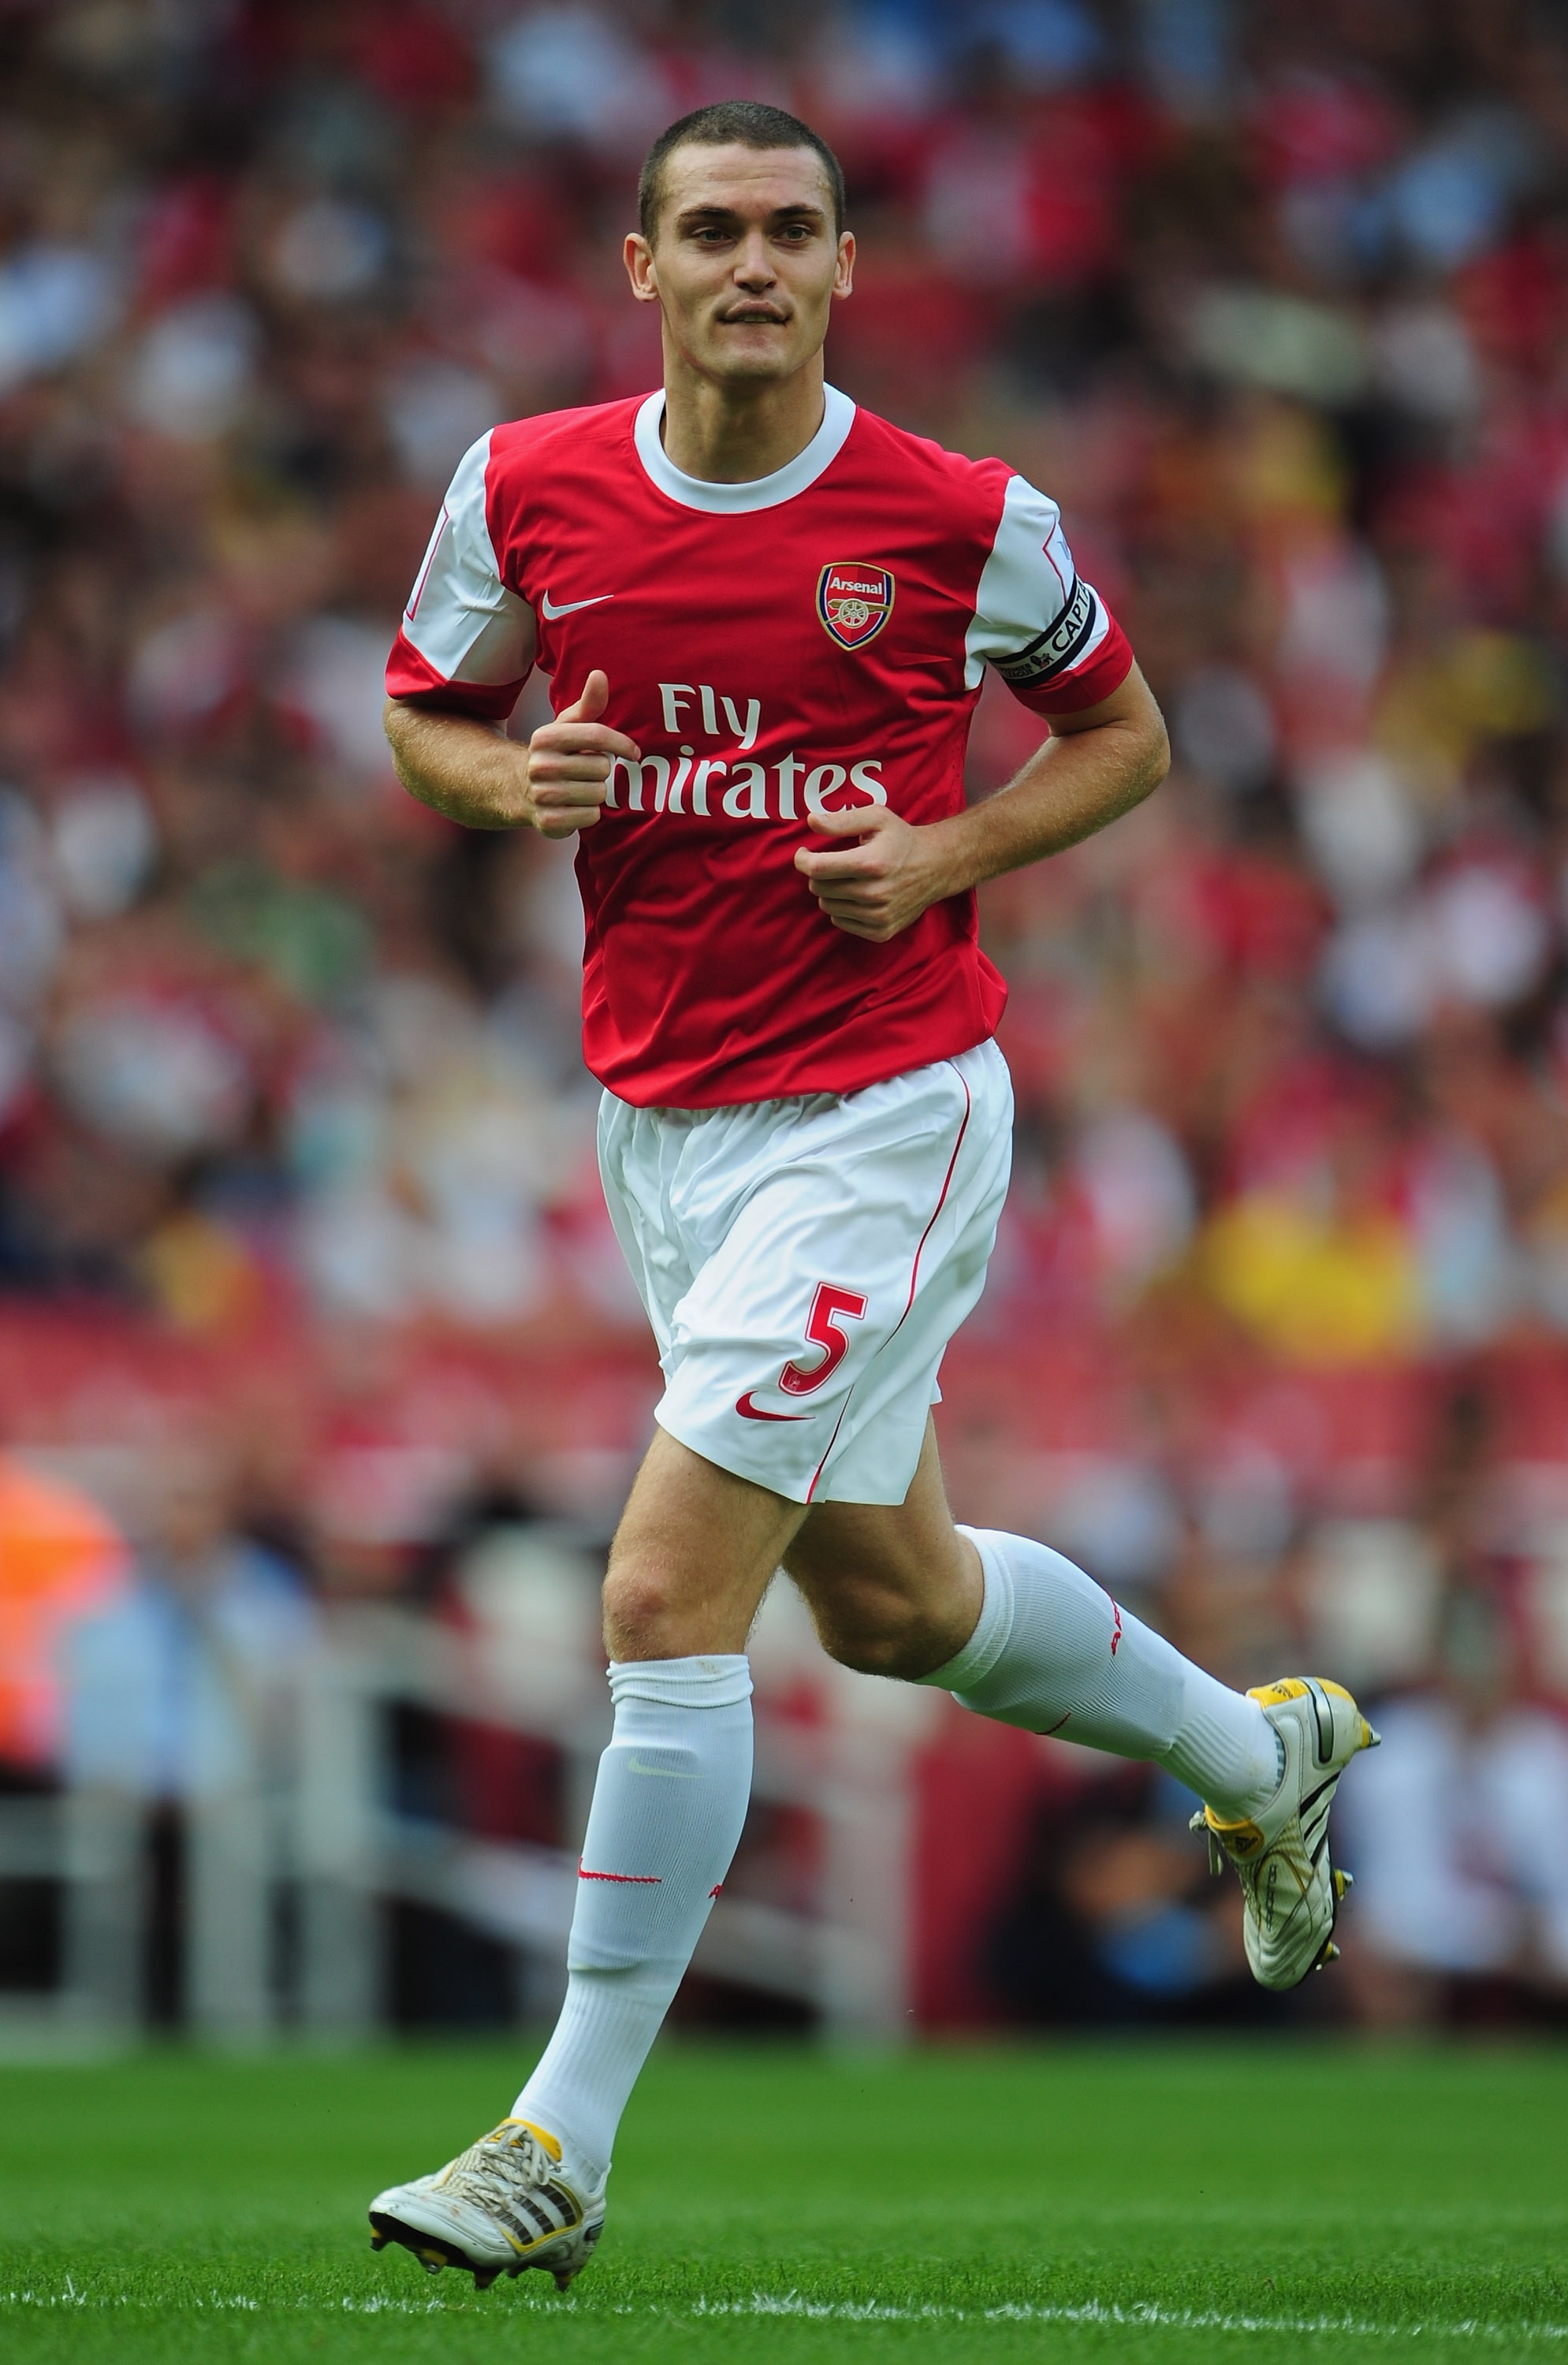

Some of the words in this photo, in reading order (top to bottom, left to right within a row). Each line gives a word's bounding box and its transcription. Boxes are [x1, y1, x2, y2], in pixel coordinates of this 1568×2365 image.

[829, 576, 883, 595] Arsenal
[657, 683, 762, 750] Fly
[602, 744, 888, 821] mirates
[778, 1281, 869, 1397] 5
